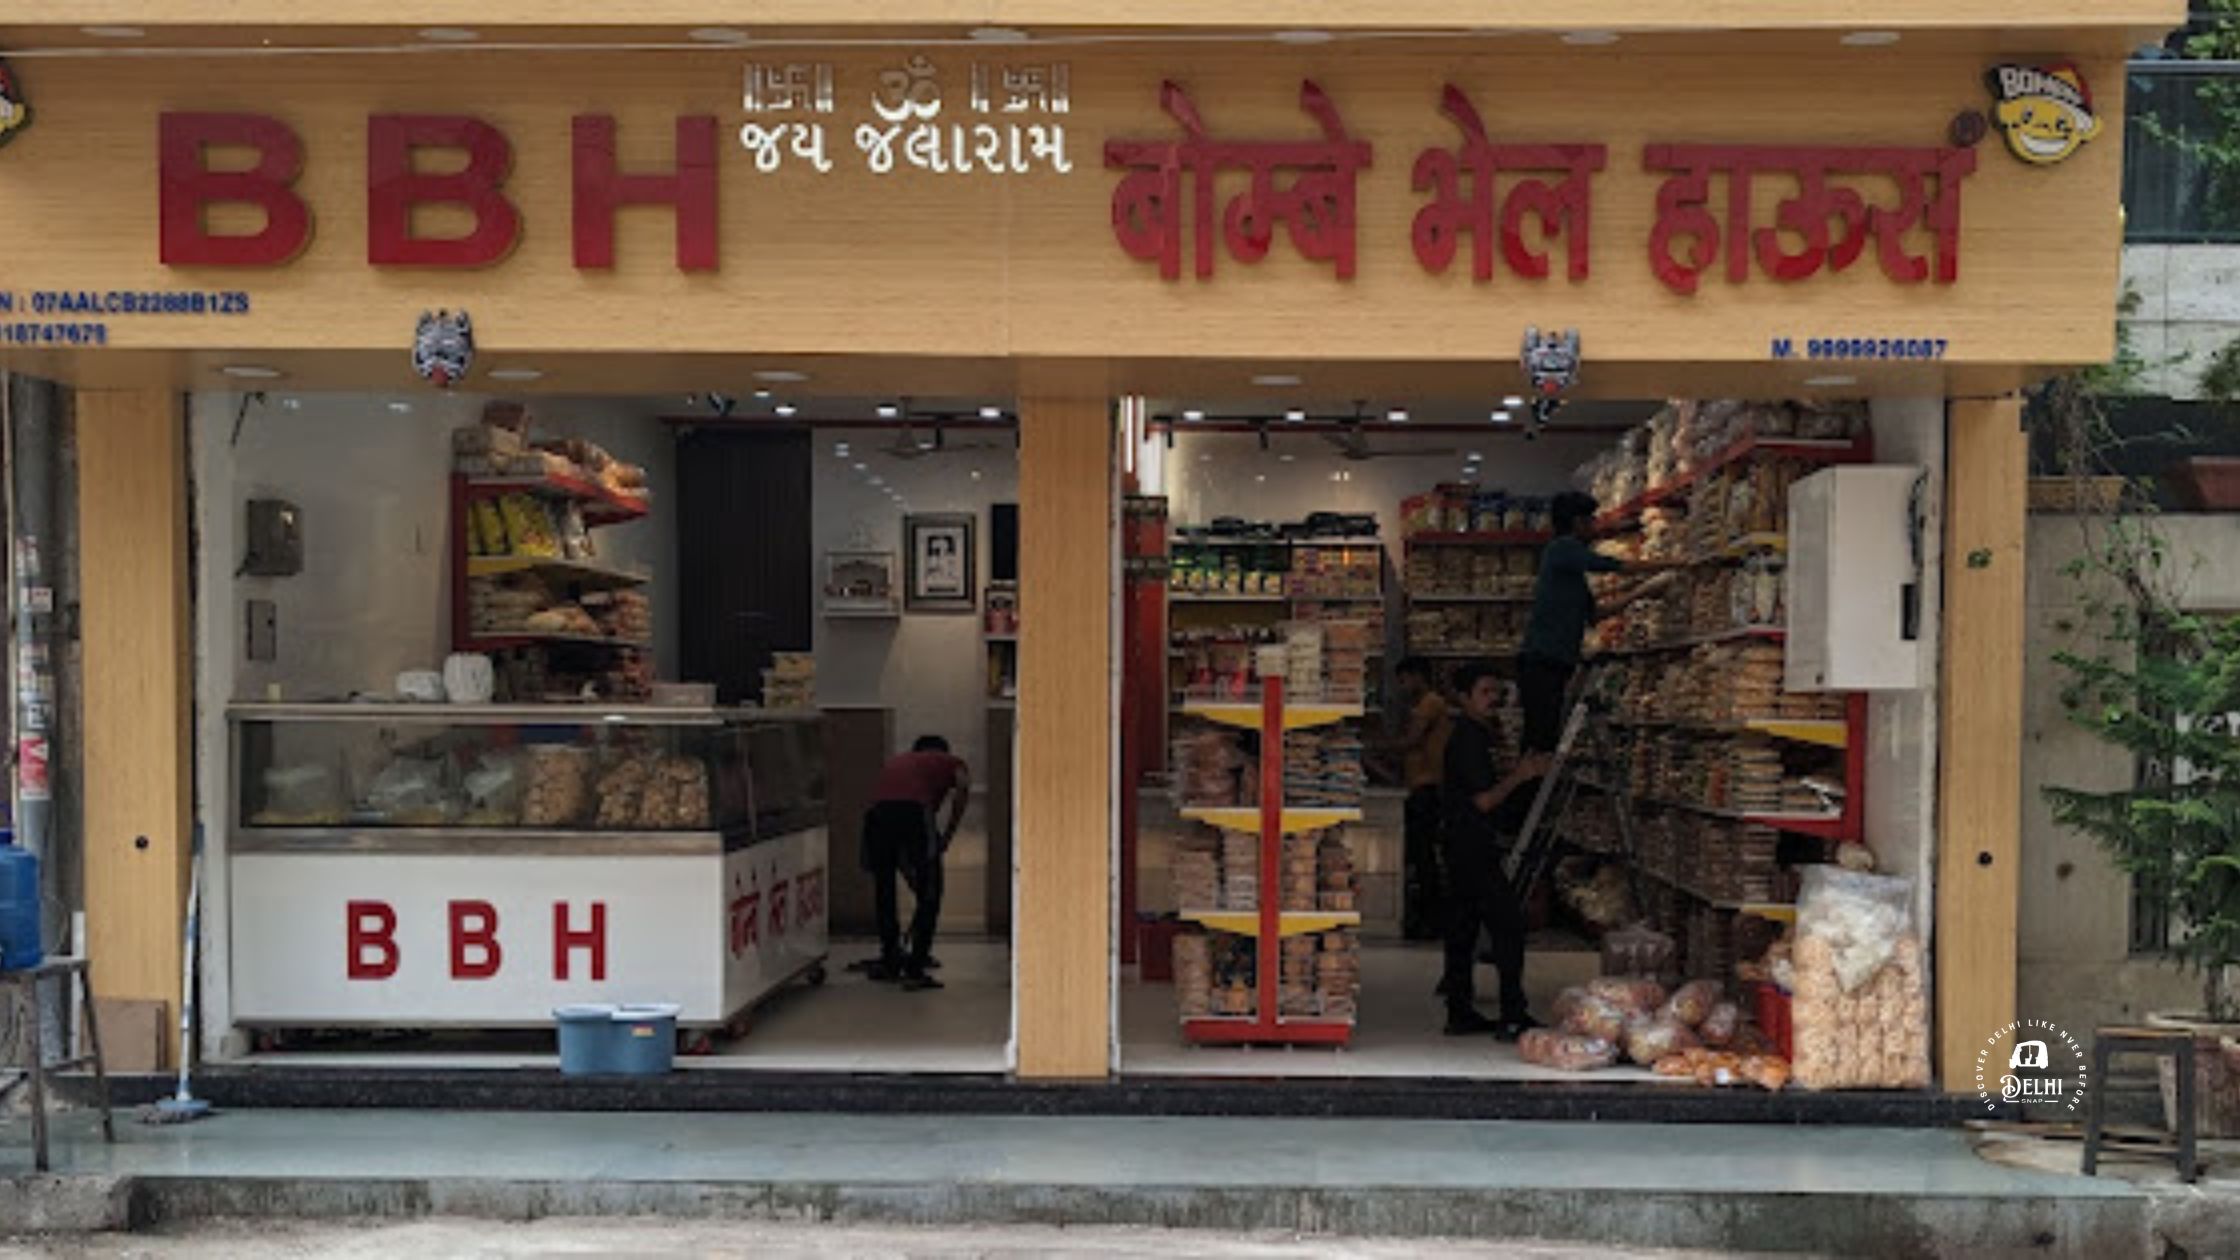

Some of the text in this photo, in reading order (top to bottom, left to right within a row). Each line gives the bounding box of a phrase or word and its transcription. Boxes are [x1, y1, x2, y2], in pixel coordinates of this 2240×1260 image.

[740, 123, 1073, 172] જય જલારામ
[1103, 79, 1373, 282] बोम्बे
[1411, 82, 1608, 284] भेल
